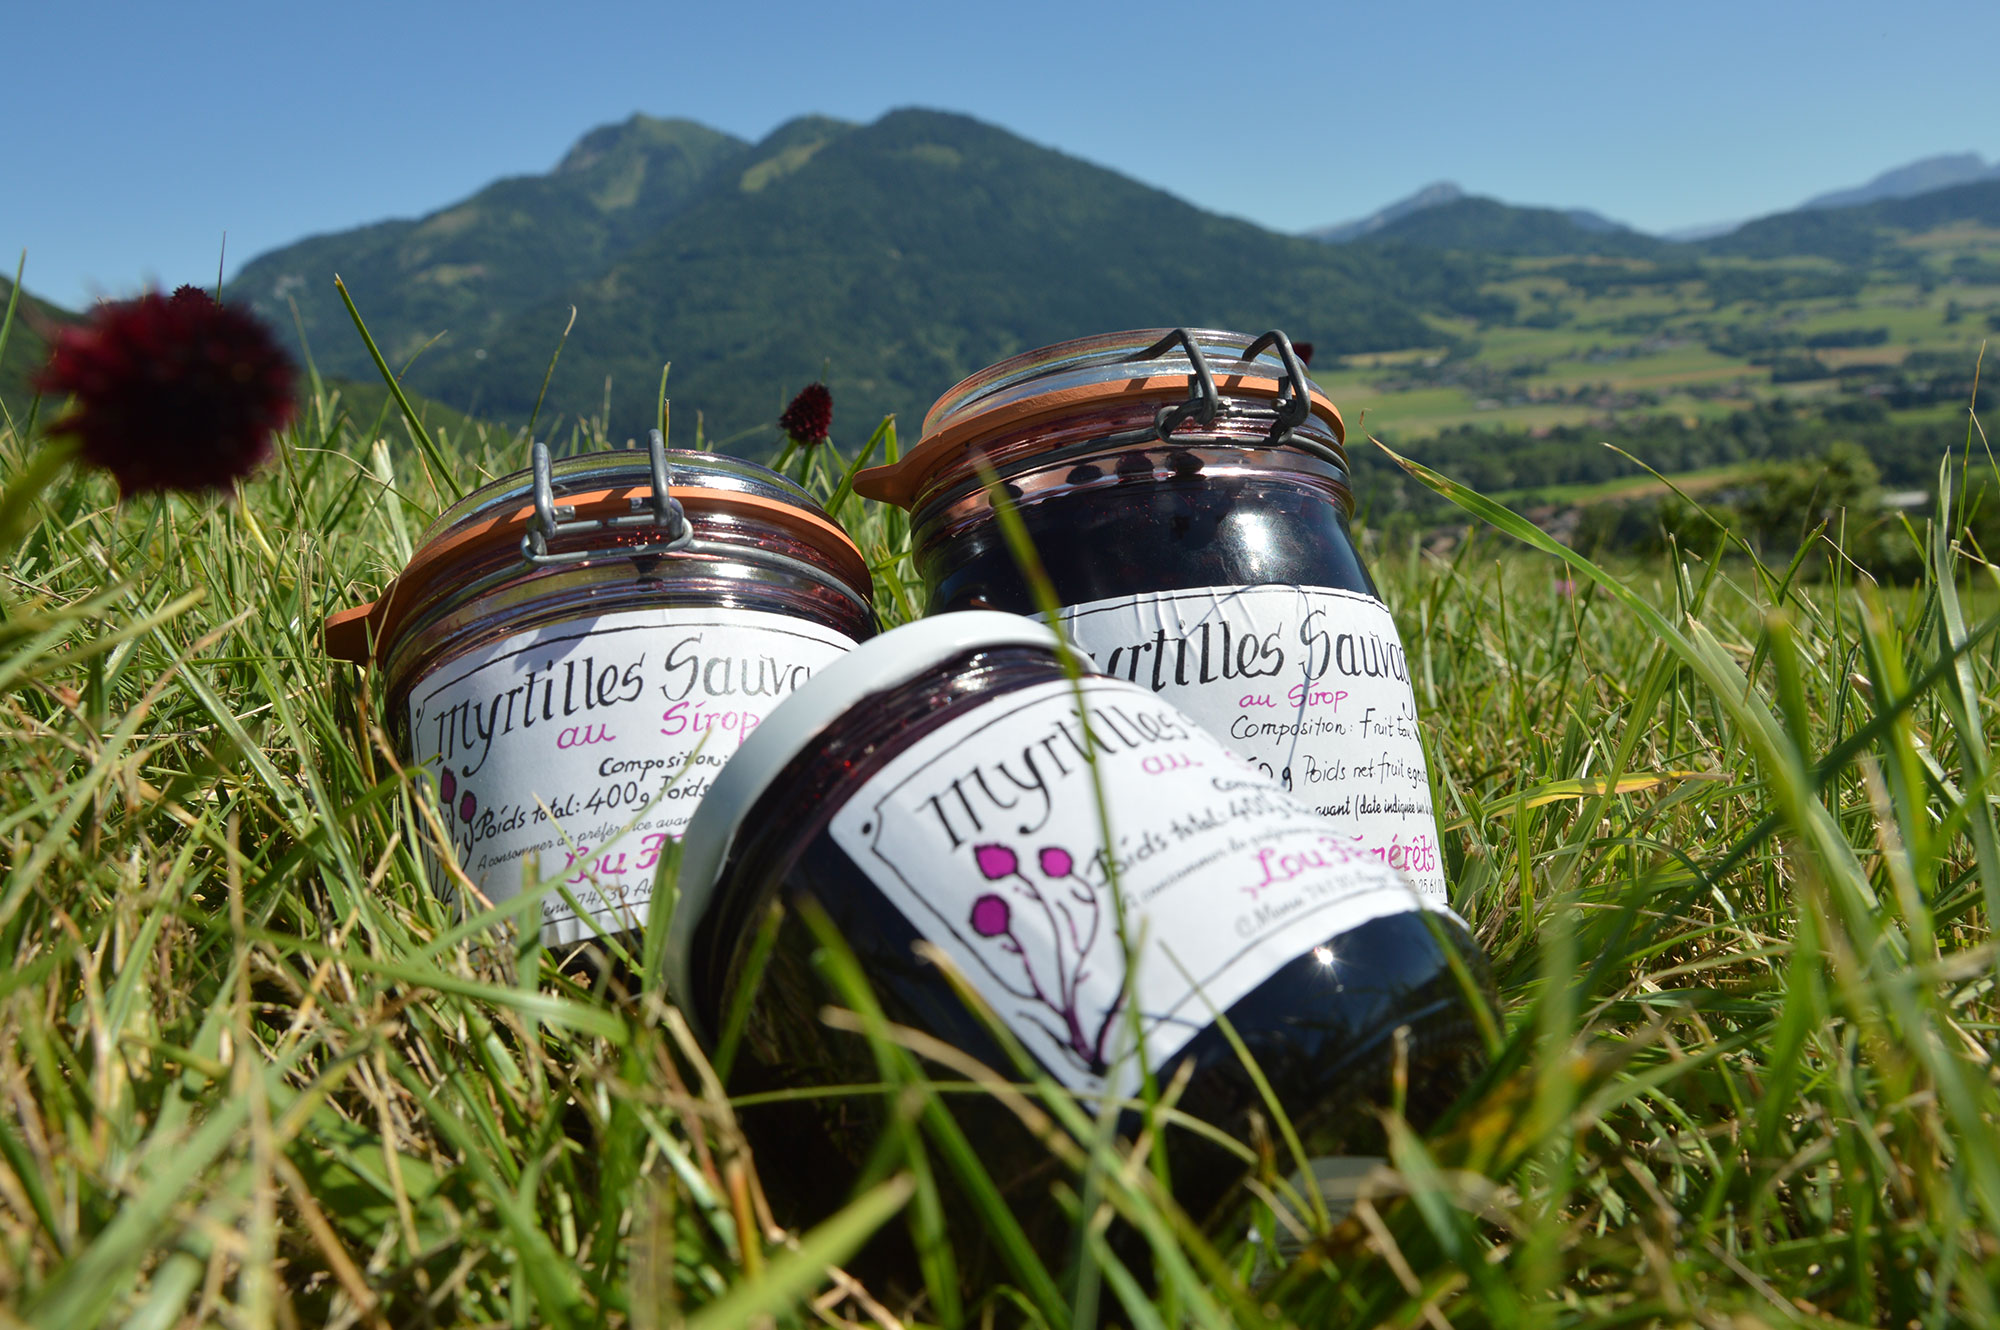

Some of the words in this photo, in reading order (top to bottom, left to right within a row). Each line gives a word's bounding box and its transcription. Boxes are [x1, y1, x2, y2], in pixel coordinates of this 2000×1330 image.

[1238, 693, 1277, 709] au
[1287, 681, 1349, 713] Sirop
[557, 723, 616, 749] au
[660, 701, 761, 746] Sirop
[1359, 707, 1394, 739] Fruit
[1302, 754, 1346, 786] Poids
[1378, 751, 1405, 785] fruit
[474, 804, 526, 843] Poids
[583, 781, 650, 817] 400g
[1315, 795, 1351, 817] avant
[1355, 793, 1382, 822] (date
